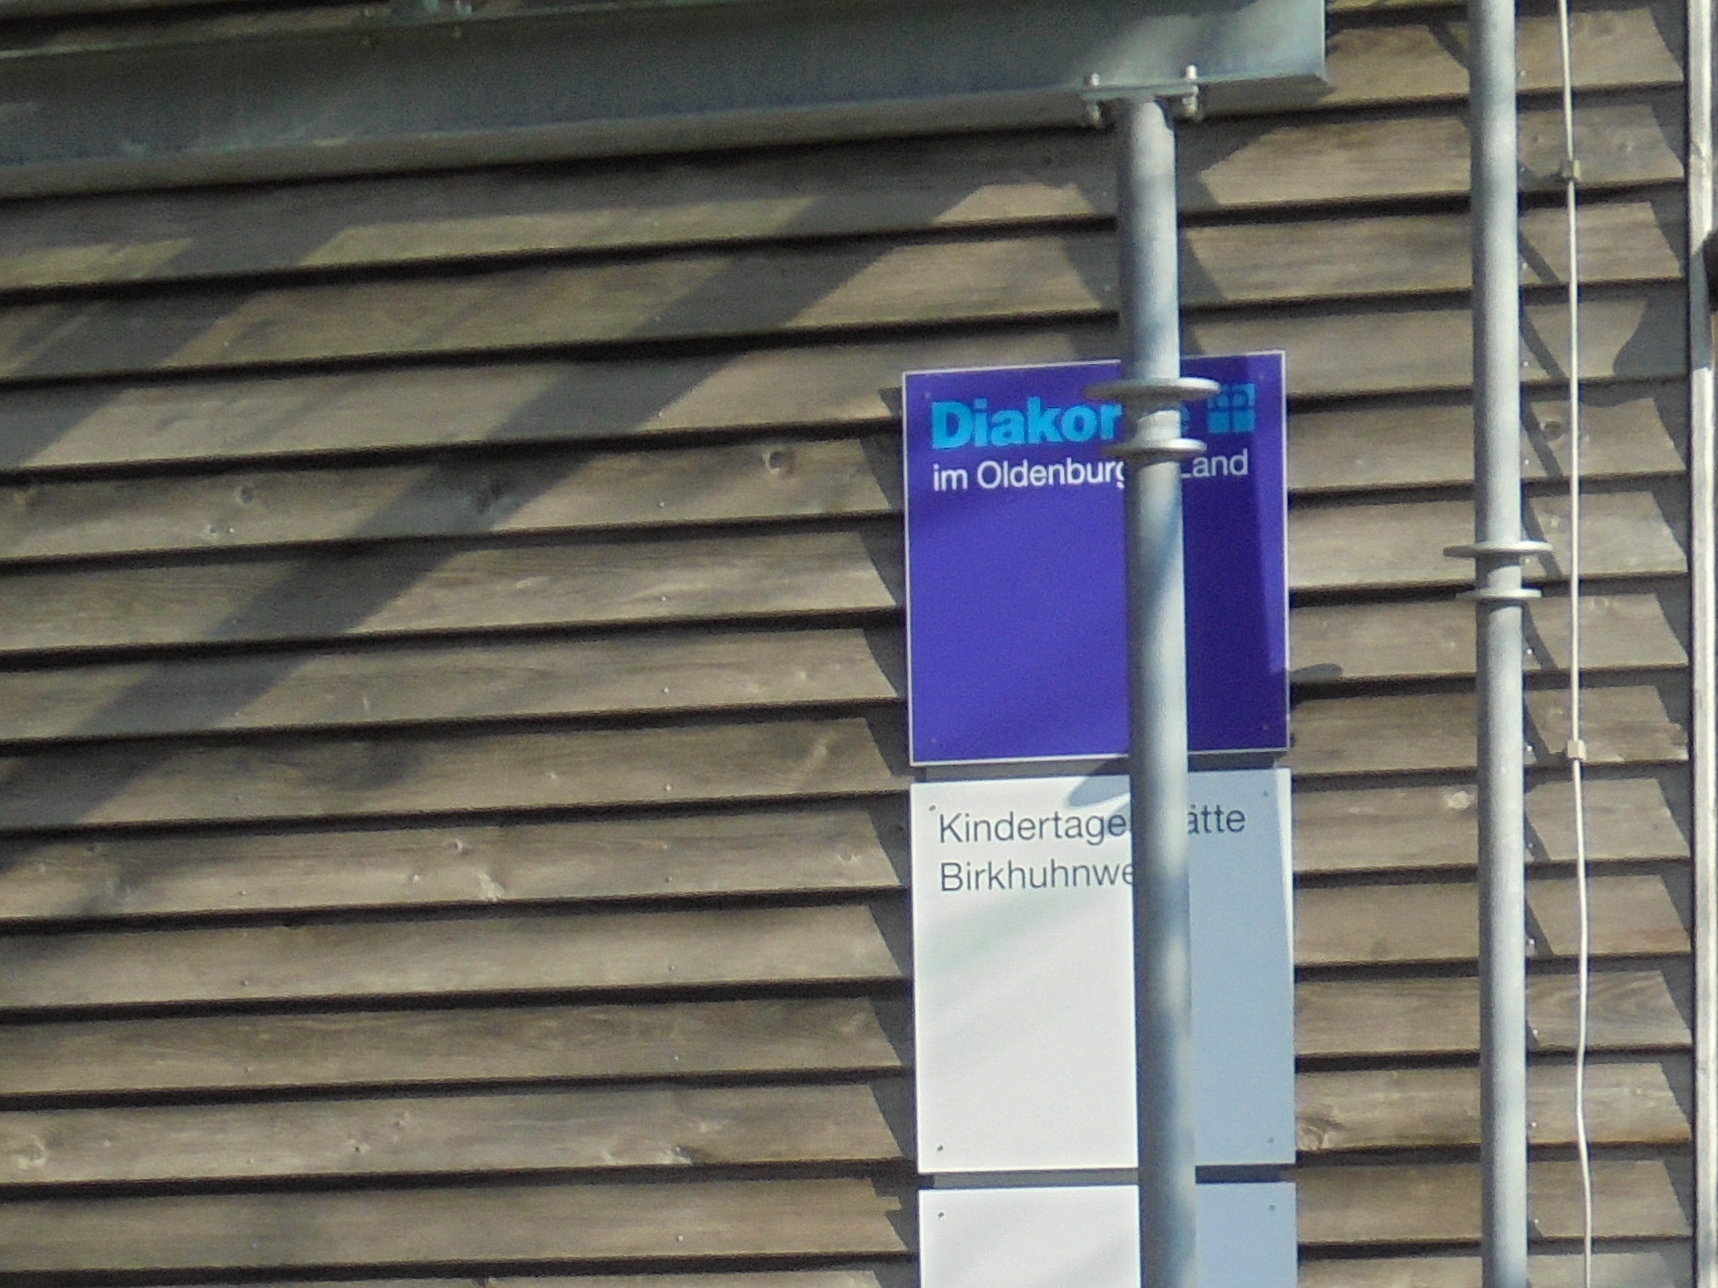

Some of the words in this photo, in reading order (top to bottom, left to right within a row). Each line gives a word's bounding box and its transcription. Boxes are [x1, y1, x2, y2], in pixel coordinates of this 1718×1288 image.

[931, 394, 1190, 450] Diakon
[932, 464, 968, 492] im
[938, 803, 1247, 846] Kindertageätte
[939, 859, 1133, 892] Birkhuhnwe
